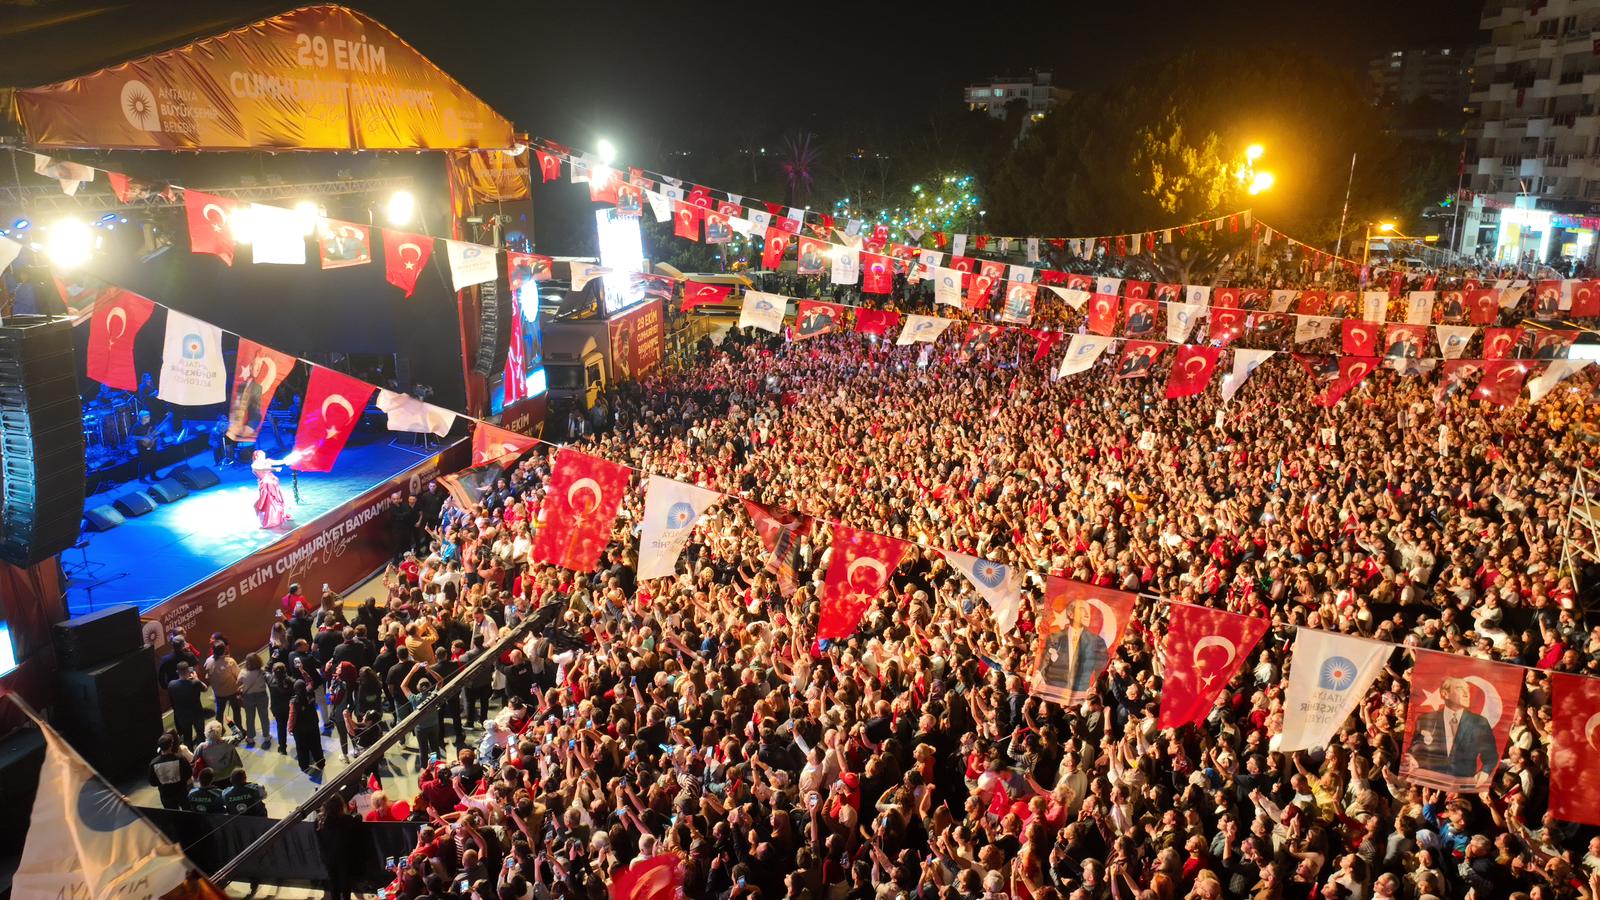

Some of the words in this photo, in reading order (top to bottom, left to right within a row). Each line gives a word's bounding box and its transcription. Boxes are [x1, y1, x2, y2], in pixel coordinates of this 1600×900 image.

[296, 33, 329, 68] 29
[333, 34, 388, 75] EKİM
[159, 87, 198, 102] ANTALYA
[229, 71, 351, 104] CUMHURİYET
[511, 412, 530, 432] EKİM
[217, 585, 237, 609] 29
[239, 564, 274, 596] EKİM
[275, 522, 346, 575] CUMHURİYET
[345, 490, 403, 533] BAYRAMI
[164, 603, 191, 623] ANTALYA
